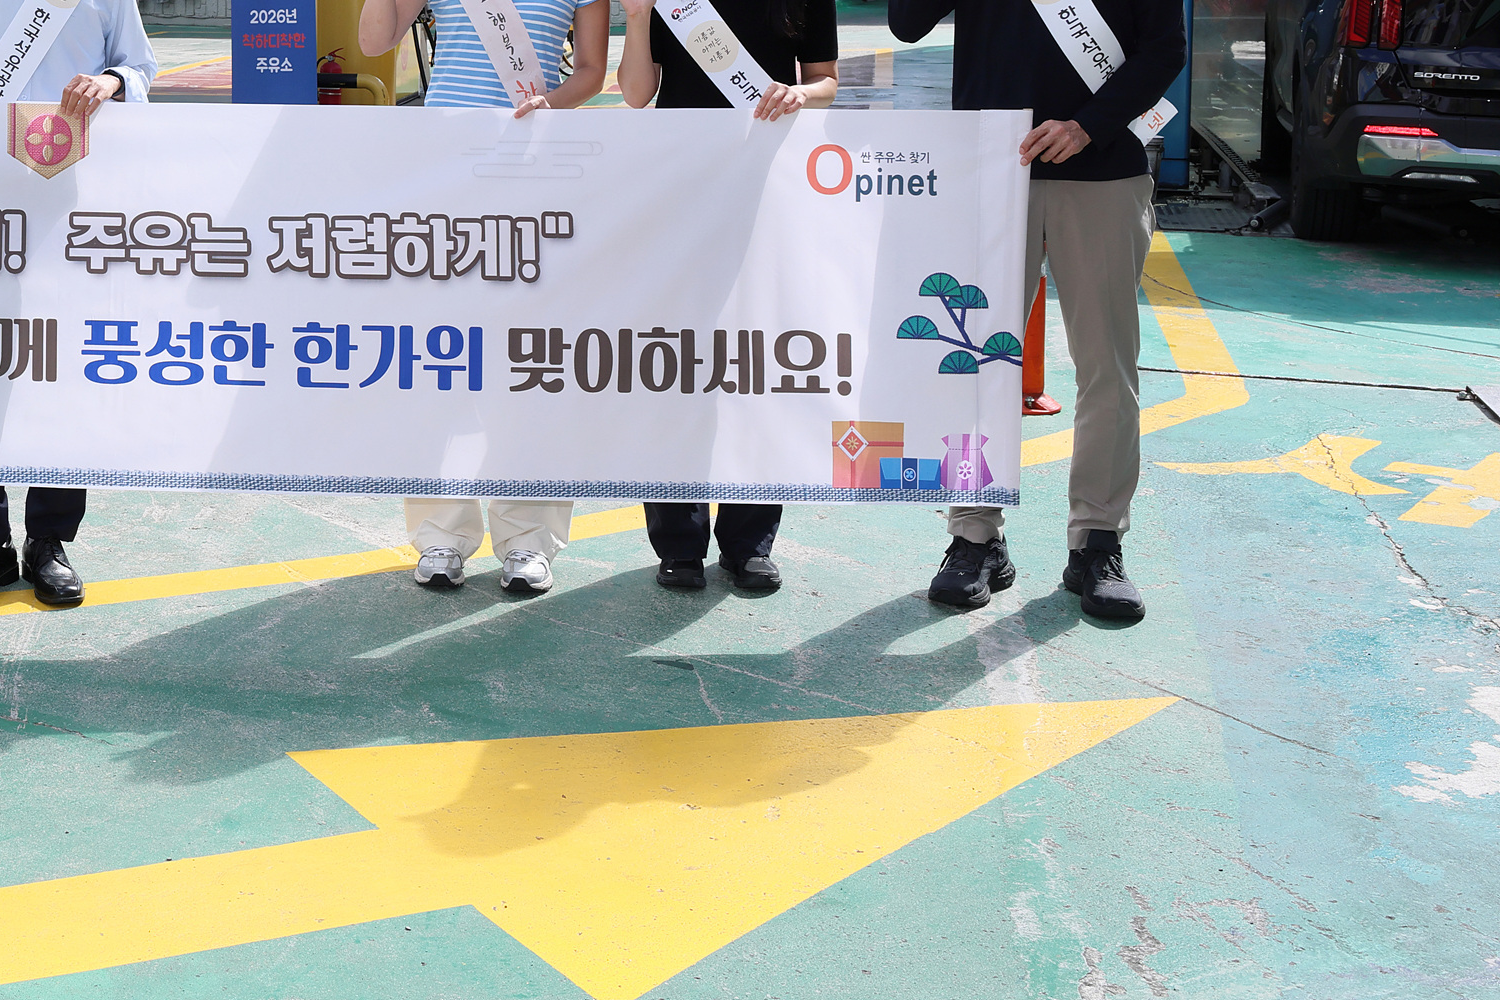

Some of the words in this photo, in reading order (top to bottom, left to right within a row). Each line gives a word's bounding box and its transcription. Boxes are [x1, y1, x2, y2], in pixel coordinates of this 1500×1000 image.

[250, 9, 297, 24] 2026년
[242, 33, 306, 49] 착하디착한
[486, 11, 524, 71] 행복한
[702, 37, 722, 54] 아끼는
[1058, 5, 1116, 80] 한국석유공
[709, 45, 731, 63] 지름길
[256, 57, 293, 73] 주유소
[1414, 72, 1480, 81] SORENTO
[860, 151, 871, 164] 싼
[874, 151, 906, 164] 주유소
[908, 151, 930, 165] 찾기
[806, 143, 938, 202] Opinet
[65, 211, 251, 278] 주유는
[266, 210, 574, 283] 저렴하게!"
[80, 318, 274, 387] 풍성한
[292, 320, 483, 391] 한가위
[507, 326, 853, 397] 맞이하세요!
